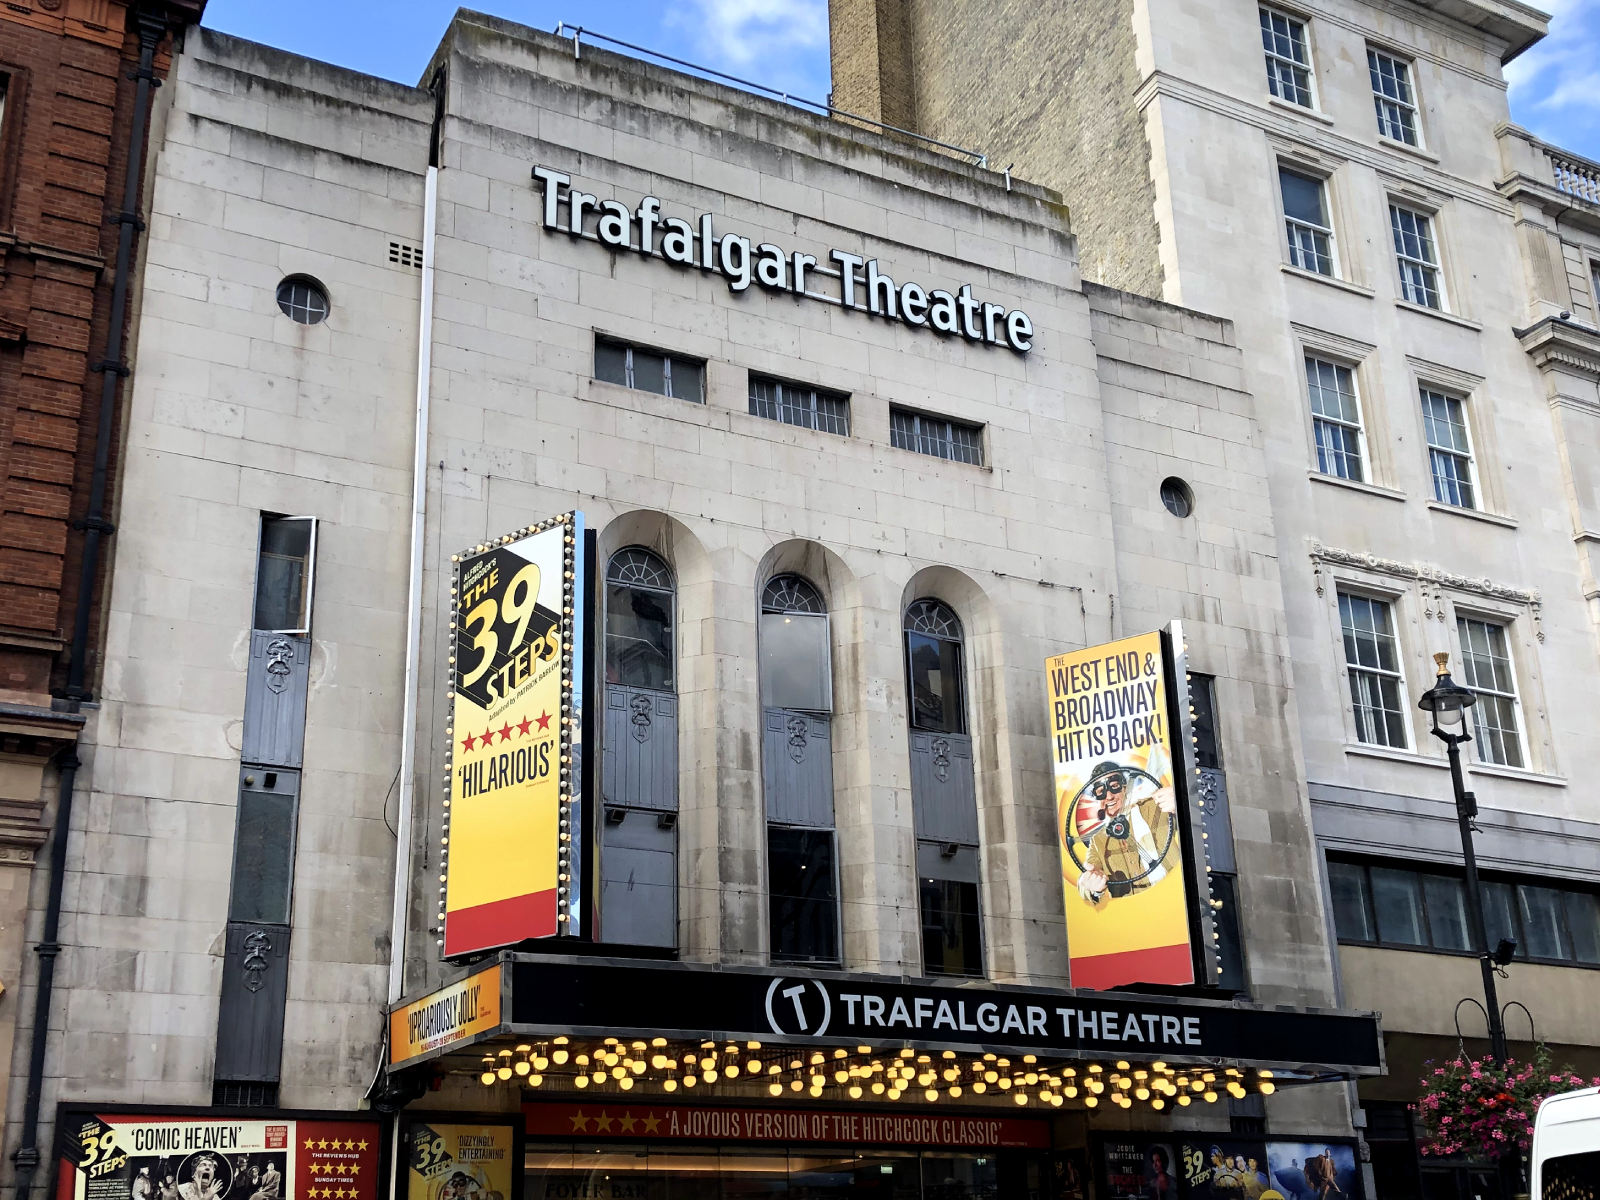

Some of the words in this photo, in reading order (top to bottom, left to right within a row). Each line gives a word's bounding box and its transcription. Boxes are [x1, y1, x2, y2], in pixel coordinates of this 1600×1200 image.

[531, 164, 817, 293] Trafalgar
[829, 248, 1034, 353] Theatre
[464, 560, 483, 583] ALFRED
[463, 562, 541, 688] 39
[1052, 659, 1101, 697] WEST
[1105, 651, 1140, 686] END
[1144, 652, 1156, 677] &
[1054, 657, 1065, 667] THE
[489, 701, 510, 722] Adapted
[509, 697, 516, 707] by
[517, 678, 538, 700] PATRICK
[538, 660, 560, 683] BARLOW
[1054, 679, 1158, 731] BROADWAY
[1057, 730, 1084, 763] HIT
[1088, 727, 1105, 758] IS
[1107, 713, 1163, 754] BACK!
[458, 740, 554, 799] 'HILARIOUS'
[840, 994, 1048, 1036] TRAFALGAR
[1056, 1008, 1201, 1045] THEATRE
[444, 1029, 466, 1044] SEPTEMBER
[683, 1111, 740, 1138] JOYOUS
[744, 1112, 808, 1139] VERSION
[812, 1114, 829, 1140] OF
[832, 1115, 859, 1141] THE
[863, 1116, 939, 1143] HITCHCOCK
[79, 1130, 118, 1168] 39
[416, 1137, 446, 1170] 39
[1109, 1152, 1144, 1160] WHITTAKER
[1116, 1145, 1135, 1153] JODIE
[1184, 1150, 1204, 1179] 39
[1122, 1166, 1133, 1174] THE
[545, 1183, 603, 1198] FOYER
[611, 1184, 646, 1198] BAR
